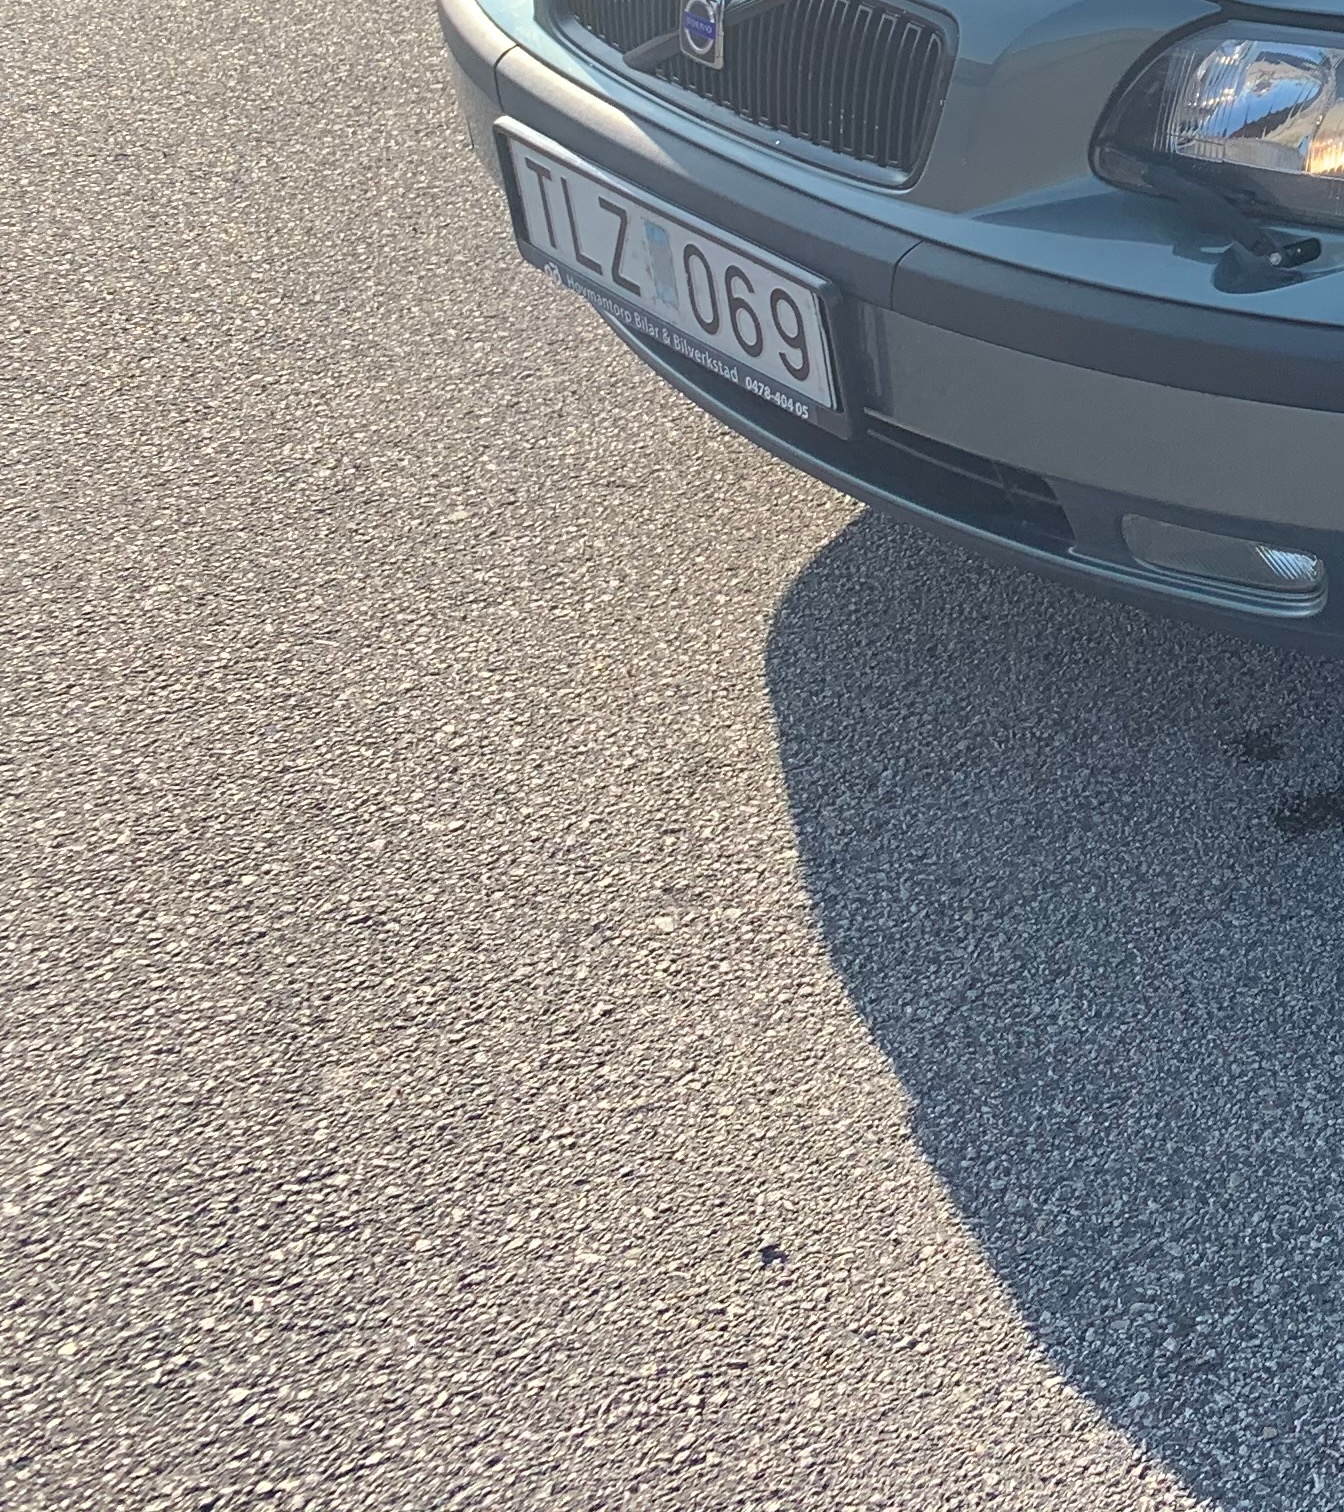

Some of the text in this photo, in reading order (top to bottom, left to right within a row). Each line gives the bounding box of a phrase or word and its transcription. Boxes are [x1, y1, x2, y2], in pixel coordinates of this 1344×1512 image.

[525, 156, 810, 382] TLZ 069
[567, 273, 632, 325] Hovmantorp
[634, 311, 660, 340] Bilar
[662, 326, 671, 346] &
[673, 333, 739, 384] Bilverkstad
